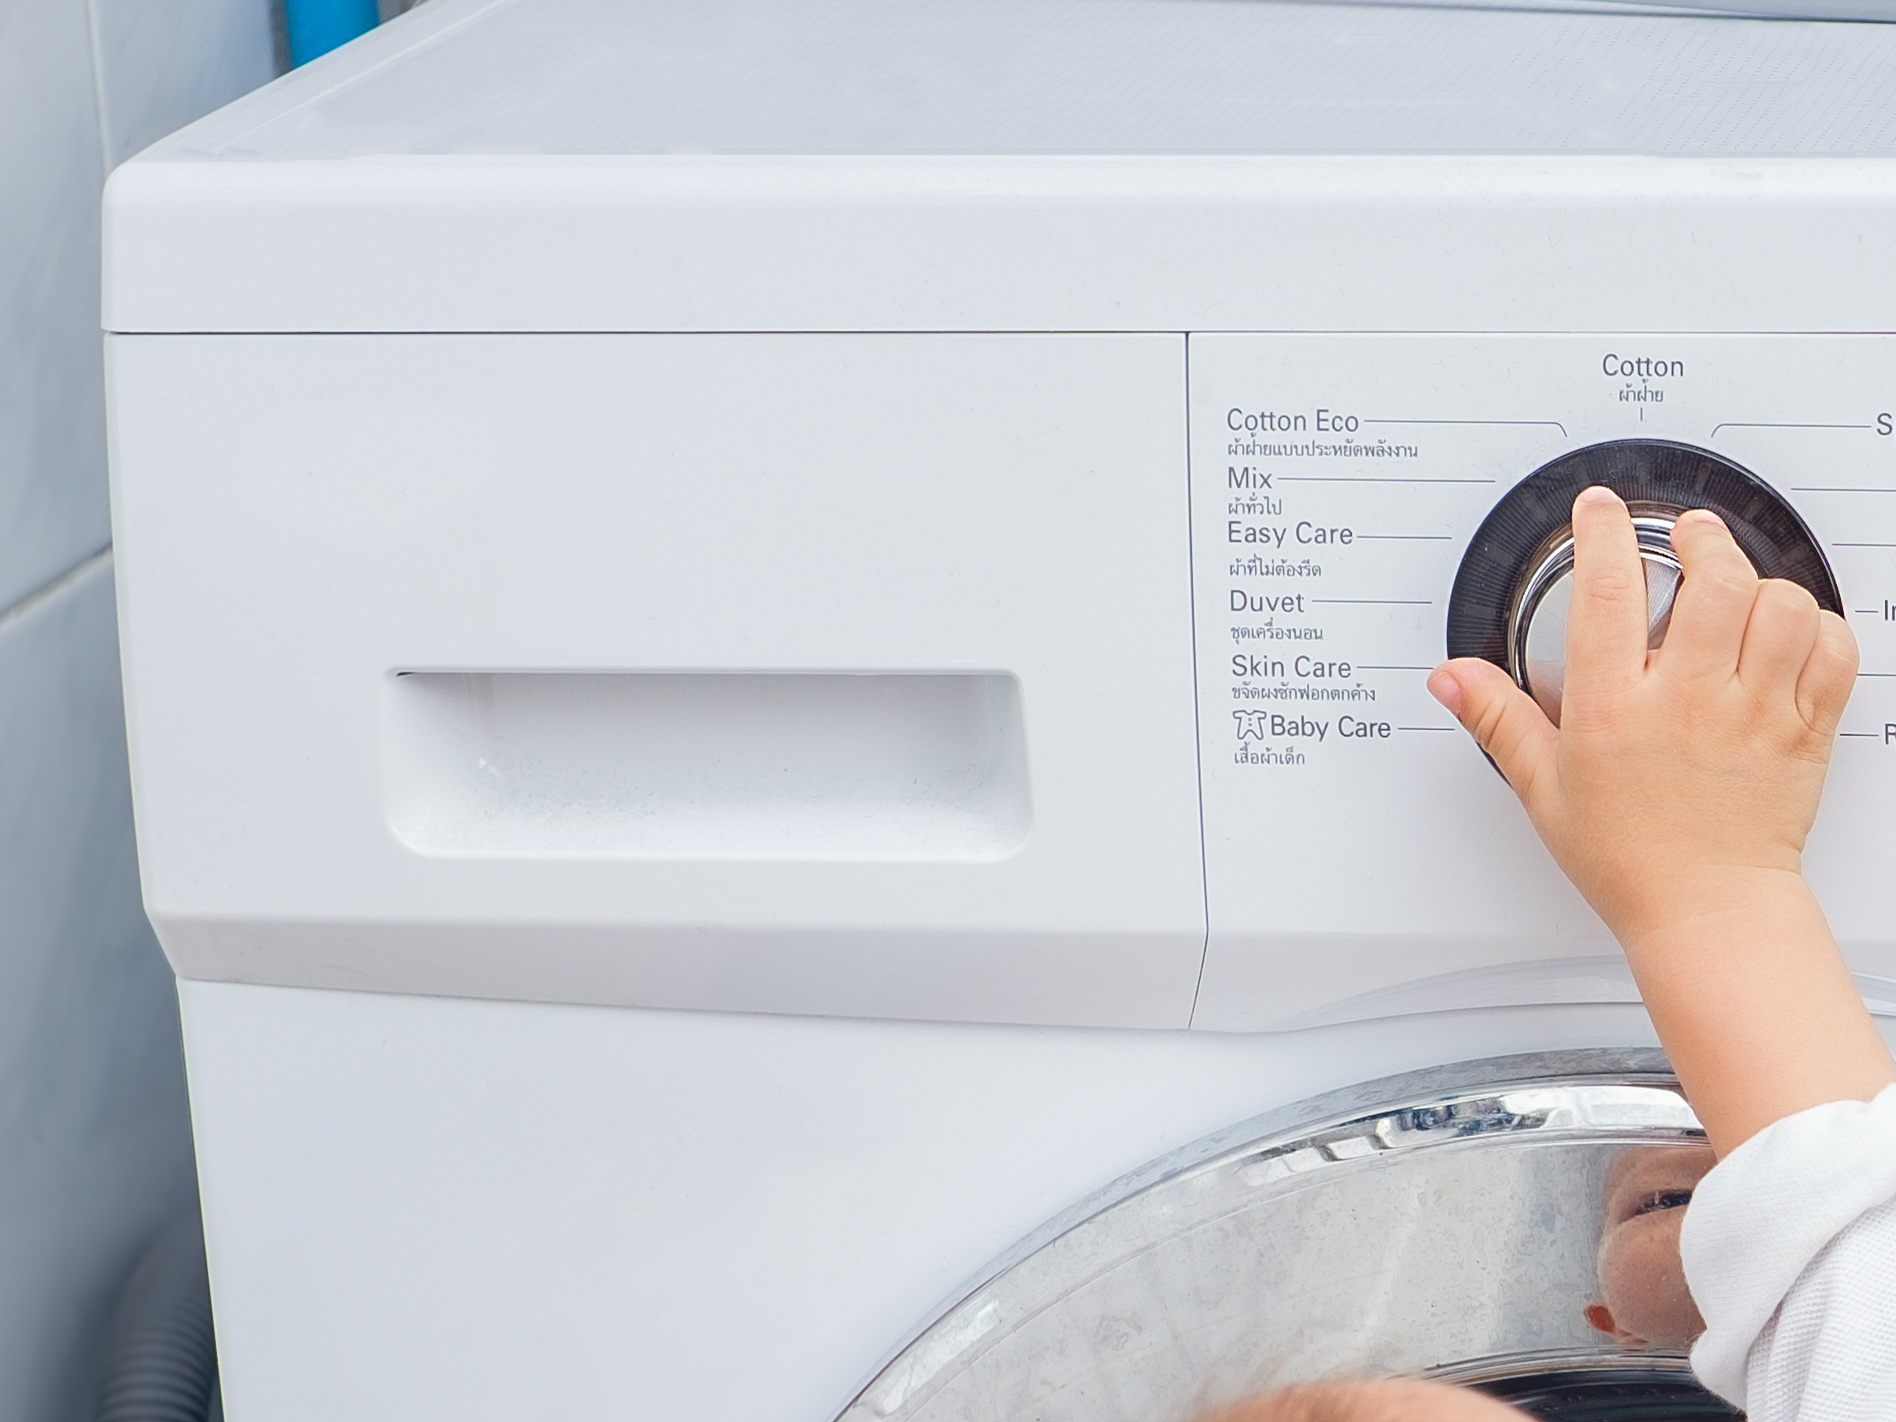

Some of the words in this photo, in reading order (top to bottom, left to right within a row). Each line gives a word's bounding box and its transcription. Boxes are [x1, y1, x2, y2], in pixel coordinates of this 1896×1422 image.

[1603, 354, 1683, 376] Cotton
[1620, 377, 1663, 402] ผ้าฝ้าย
[1228, 408, 1306, 433] Cotton
[1317, 409, 1358, 432] Eco
[1229, 467, 1272, 488] Mix
[1229, 492, 1281, 515] ผ้าทั่วไป
[1229, 521, 1286, 548] Easy
[1296, 522, 1352, 544] Care
[1230, 554, 1321, 576] ผ้าที่ไม่ต้องรีด
[1231, 590, 1304, 612] Duvet
[1231, 617, 1323, 644] ชุดเครื่องนอน
[1233, 655, 1284, 677] Skin
[1295, 656, 1351, 678] Care
[1232, 681, 1375, 701] ขจัดผงซักฟอกตกค้าง
[1271, 715, 1328, 742] Baby
[1339, 716, 1390, 738] Care
[1235, 742, 1305, 764] เสื้อผ้าเด็ก
